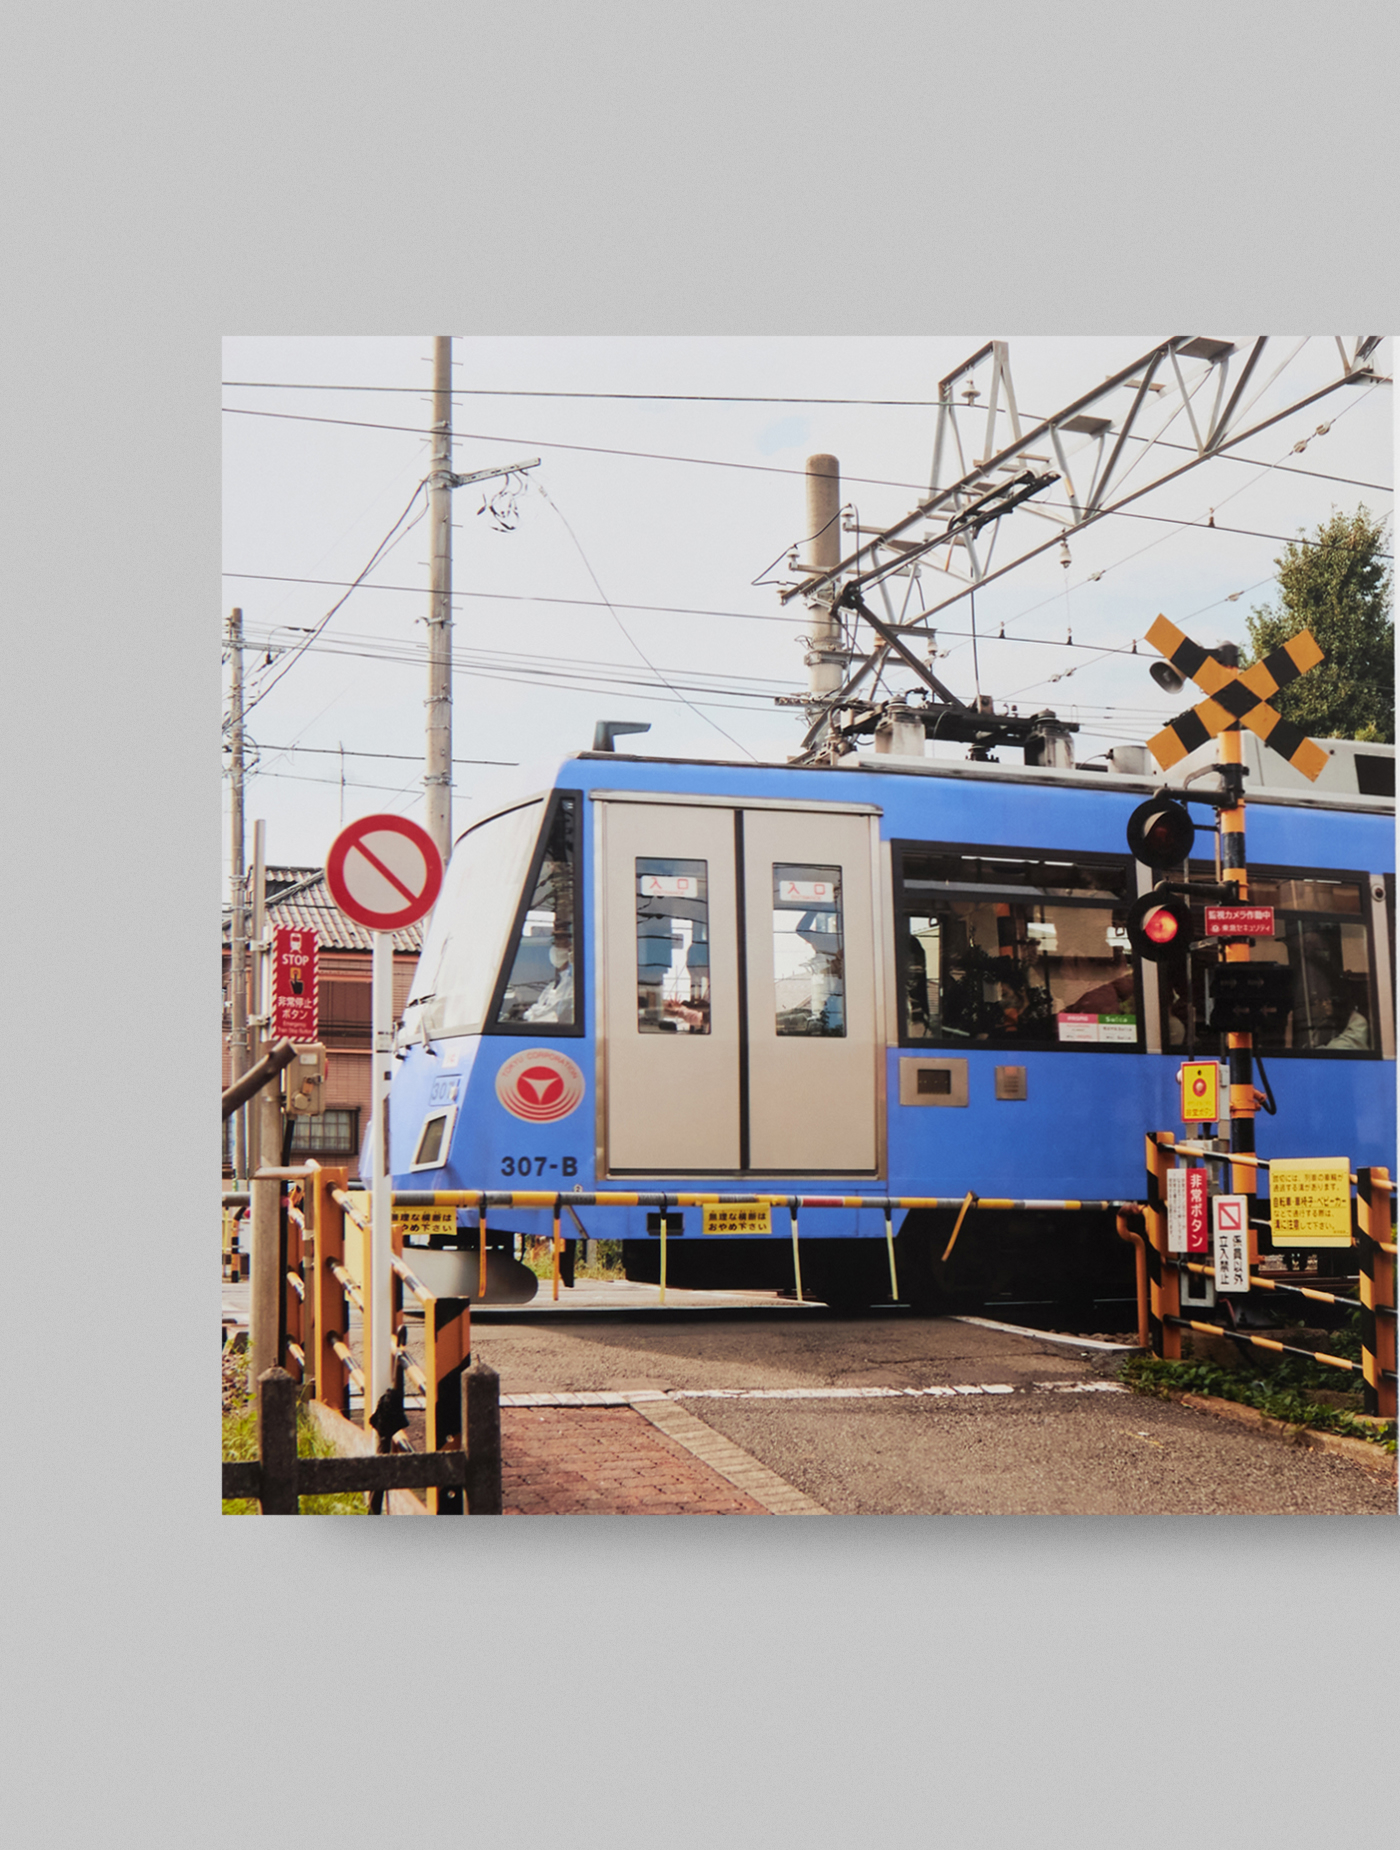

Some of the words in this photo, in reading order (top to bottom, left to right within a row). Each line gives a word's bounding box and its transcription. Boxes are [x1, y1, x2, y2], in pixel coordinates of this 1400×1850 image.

[1208, 910, 1271, 920] 監視カメラ作動中
[282, 953, 310, 966] STOP
[278, 996, 313, 1009] 非常停止
[282, 1008, 309, 1019] ボタン
[502, 1056, 524, 1077] TOKYU
[526, 1051, 578, 1079] CORPORATION
[501, 1156, 578, 1177] 307-B
[708, 1212, 767, 1221] 無理な横断は
[1190, 1173, 1203, 1247] 非常ボタン
[402, 1223, 453, 1232] やめ下さい
[708, 1222, 767, 1231] おやめ下さい
[1219, 1235, 1230, 1285] 立入禁止
[1232, 1235, 1244, 1285] 係員以外
